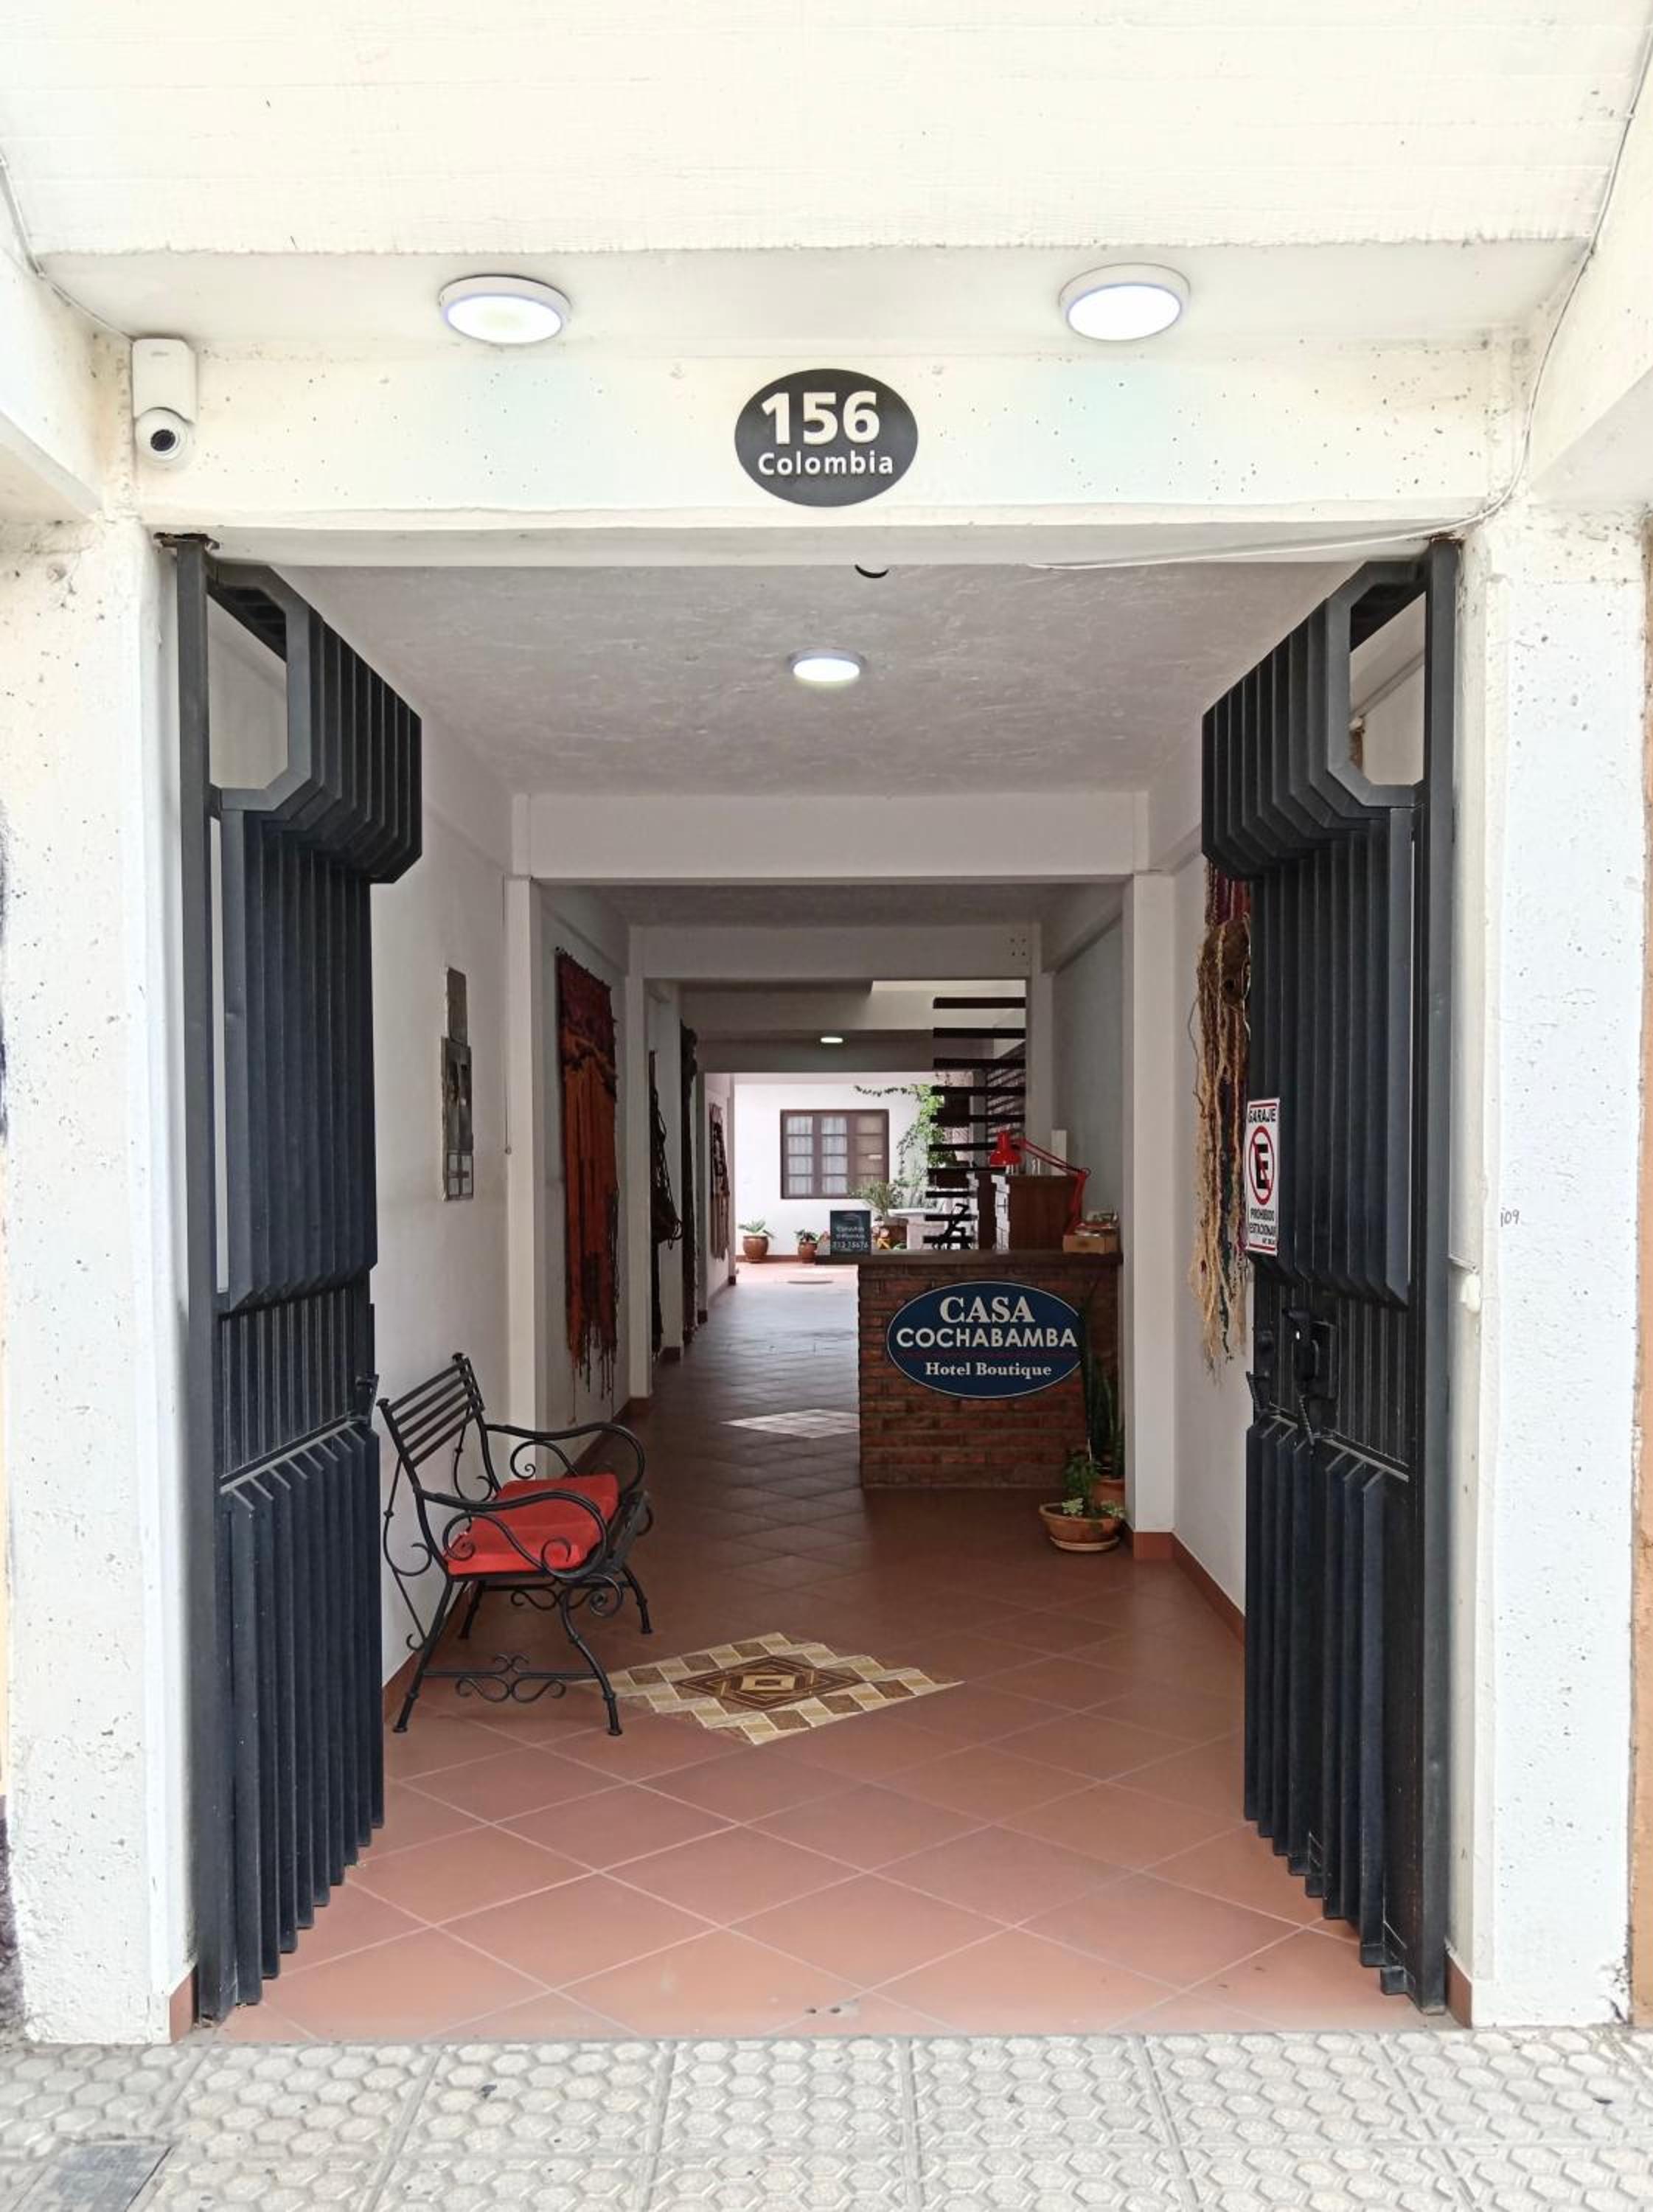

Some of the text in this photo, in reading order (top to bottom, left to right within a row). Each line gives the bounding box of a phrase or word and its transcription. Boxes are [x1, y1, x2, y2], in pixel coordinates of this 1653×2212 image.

[761, 390, 880, 445] 156
[757, 450, 894, 476] Colombia
[1247, 1108, 1276, 1122] GARAJE
[939, 1296, 1035, 1324] CASA
[896, 1328, 1078, 1348] COCHABAMBA
[925, 1362, 1052, 1380] Hotel Boutique
